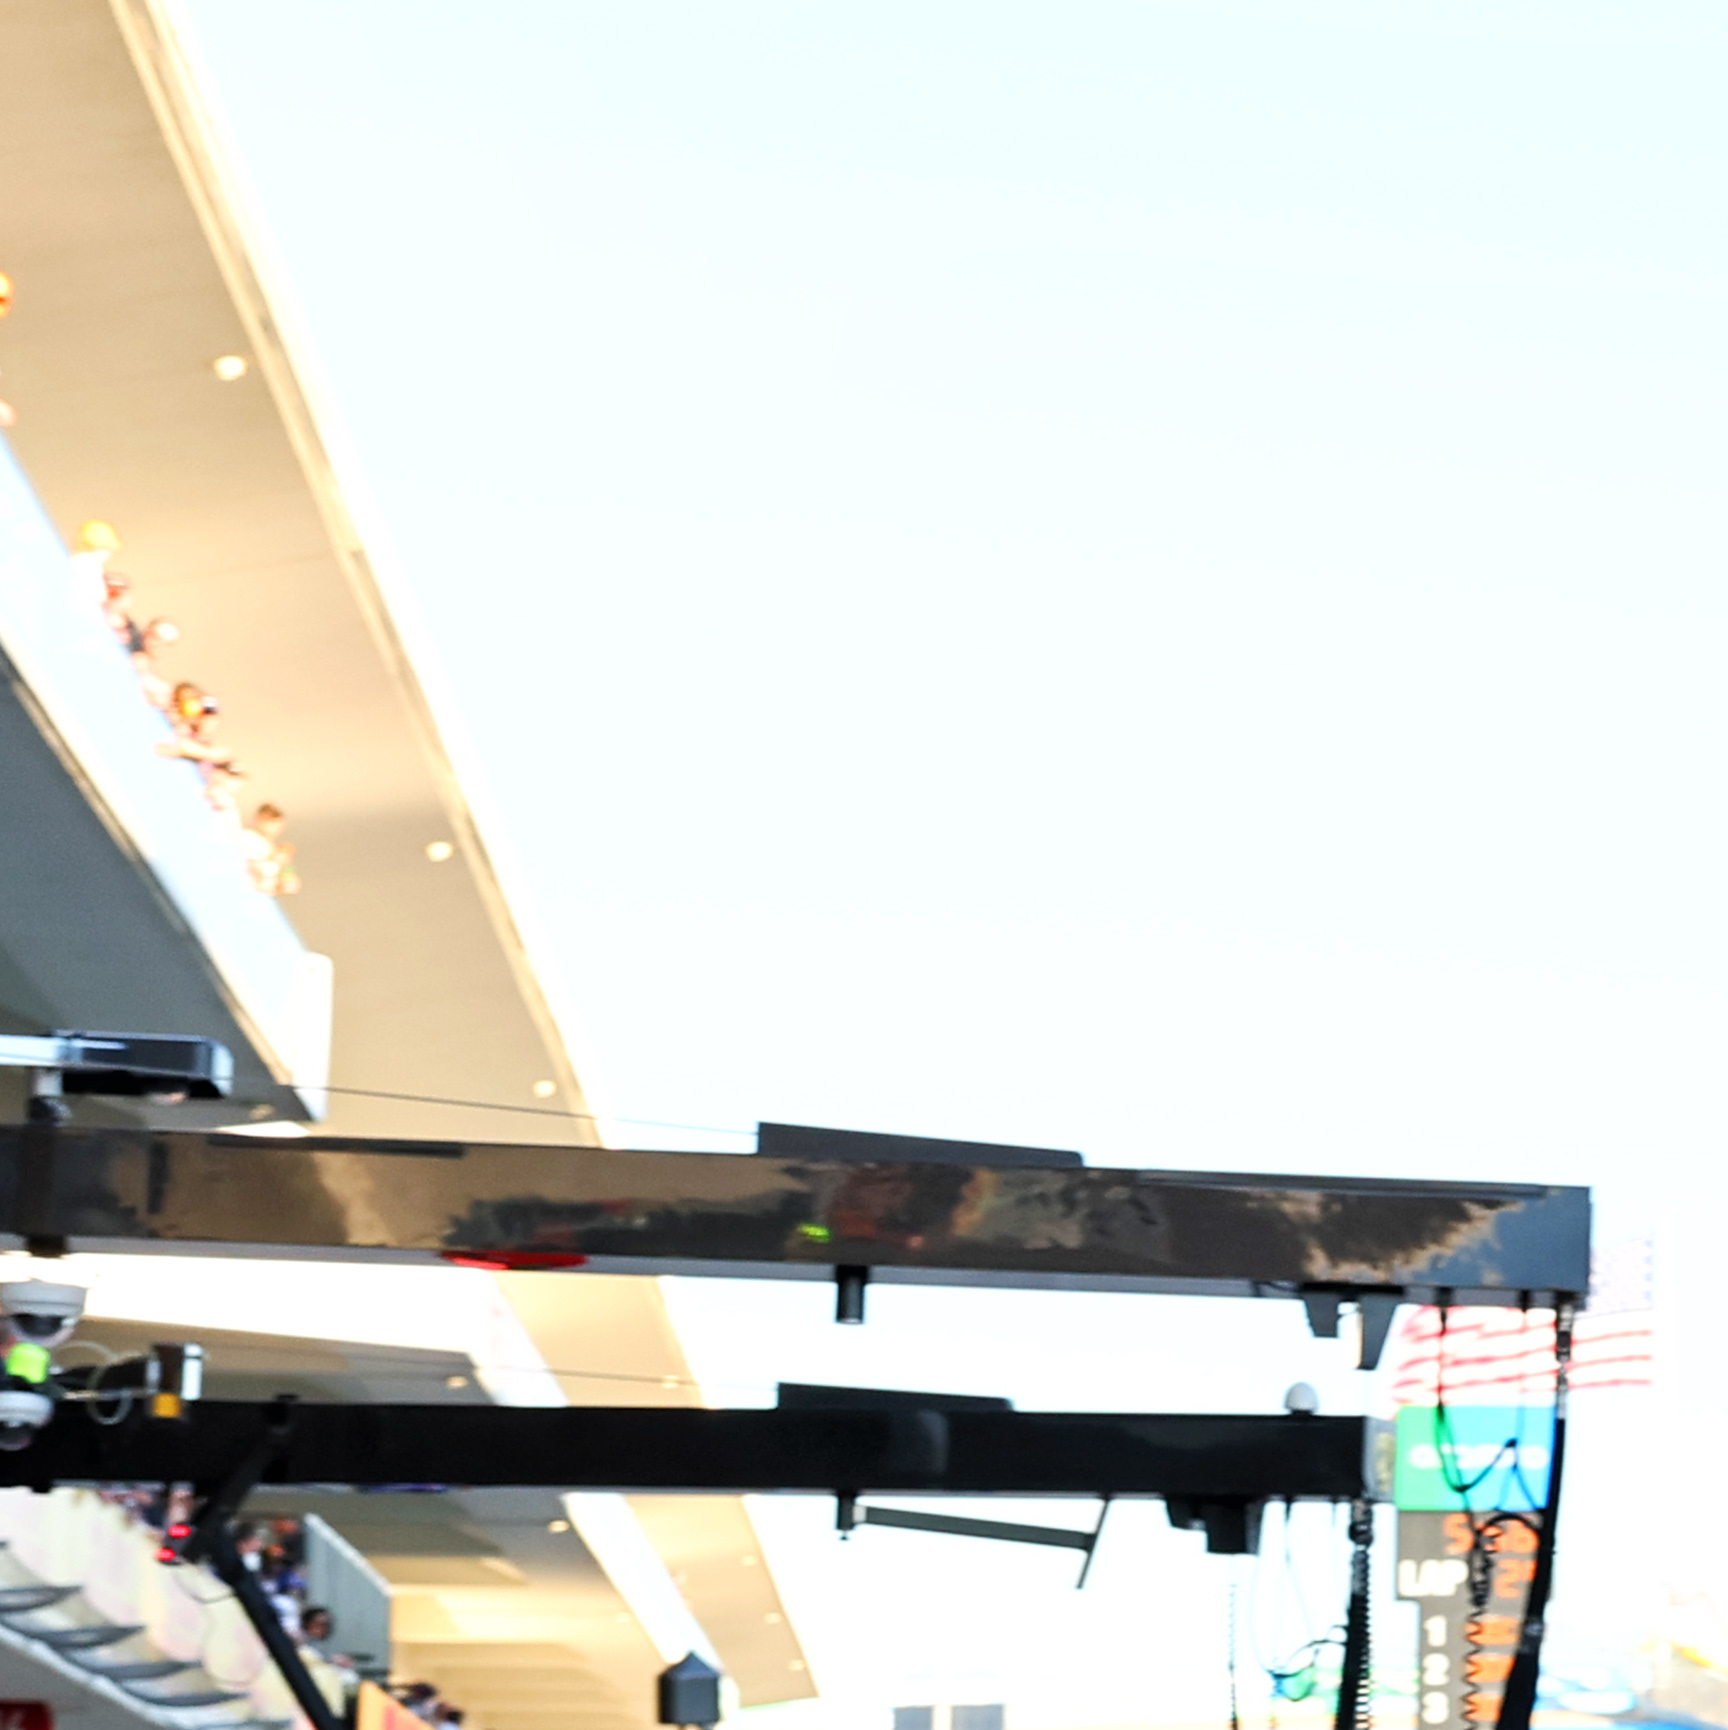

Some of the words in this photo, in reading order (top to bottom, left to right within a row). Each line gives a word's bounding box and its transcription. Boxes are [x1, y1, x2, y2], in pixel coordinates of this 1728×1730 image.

[1398, 1559, 1468, 1597] LAP
[1423, 1615, 1448, 1647] 1
[1423, 1653, 1449, 1686] 2
[1423, 1691, 1449, 1725] 3
